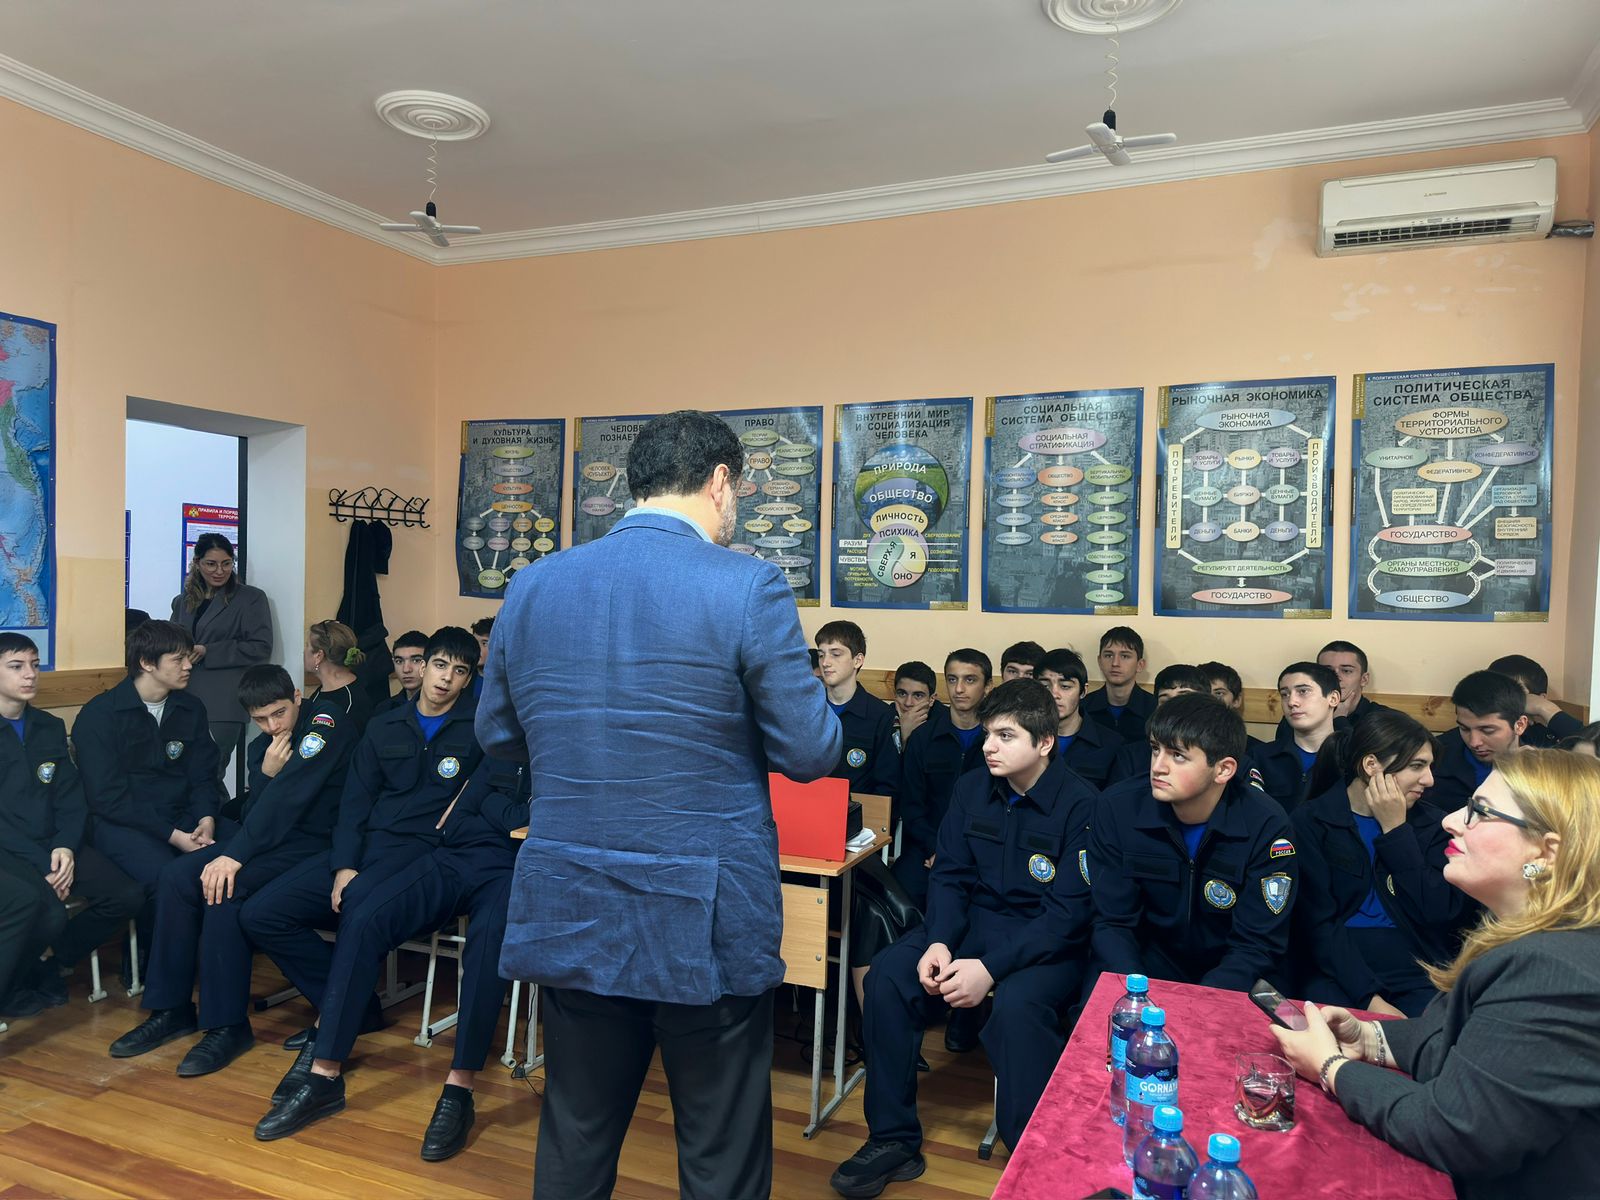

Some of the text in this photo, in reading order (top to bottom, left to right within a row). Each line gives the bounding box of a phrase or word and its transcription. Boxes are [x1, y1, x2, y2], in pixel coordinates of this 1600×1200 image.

[1394, 379, 1510, 394] ПОЛИТИЧЕСКАЯ
[1172, 390, 1322, 406] РЫНОЧНАЯ ЭКОНОМИКА
[1374, 394, 1440, 406] СИСТЕМА
[1450, 390, 1532, 402] ОБЩЕСТВА
[1024, 402, 1102, 414] СОЦИАЛЬНАЯ
[857, 409, 950, 422] ВНУТРЕННИЙ МИР
[1001, 411, 1127, 425] СИСТЕМА ОБЩЕСТВА
[1221, 412, 1270, 420] РЫНОЧНАЯ
[1432, 410, 1470, 418] ФОРМЫ
[868, 419, 950, 430] СОЦИАЛИЗАЦИЯ
[1218, 420, 1272, 428] ЭКОНОМИКА
[1400, 417, 1502, 428] ТЕРРИТОРИАЛЬНОГО
[610, 425, 644, 433] ЧЕЛОВЕ
[1419, 425, 1482, 436] УСТРОЙСТВА
[876, 430, 928, 440] ЧЕЛОВЕКА
[1036, 433, 1088, 442] СОЦИАЛЬНАЯ
[1030, 441, 1094, 450] СТРАТИФИКАЦИЯ
[1474, 450, 1536, 458] КОНФЕДЕРАТИВНОЕ
[874, 462, 927, 474] ПРИРОДА
[869, 489, 933, 503] ОБЩЕСТВО
[1310, 443, 1318, 544] ПРОИЗВОДИТЕЛИ
[876, 513, 924, 524] ЛИЧНОСТЬ
[880, 528, 920, 538] ПСИХИКА
[1390, 530, 1458, 539] ГОСУДАРСТВО
[878, 541, 897, 577] СВЕРХ-Я
[1211, 591, 1272, 600] ГОСУДАРСТВО
[1396, 594, 1449, 603] ОБЩЕСТВО
